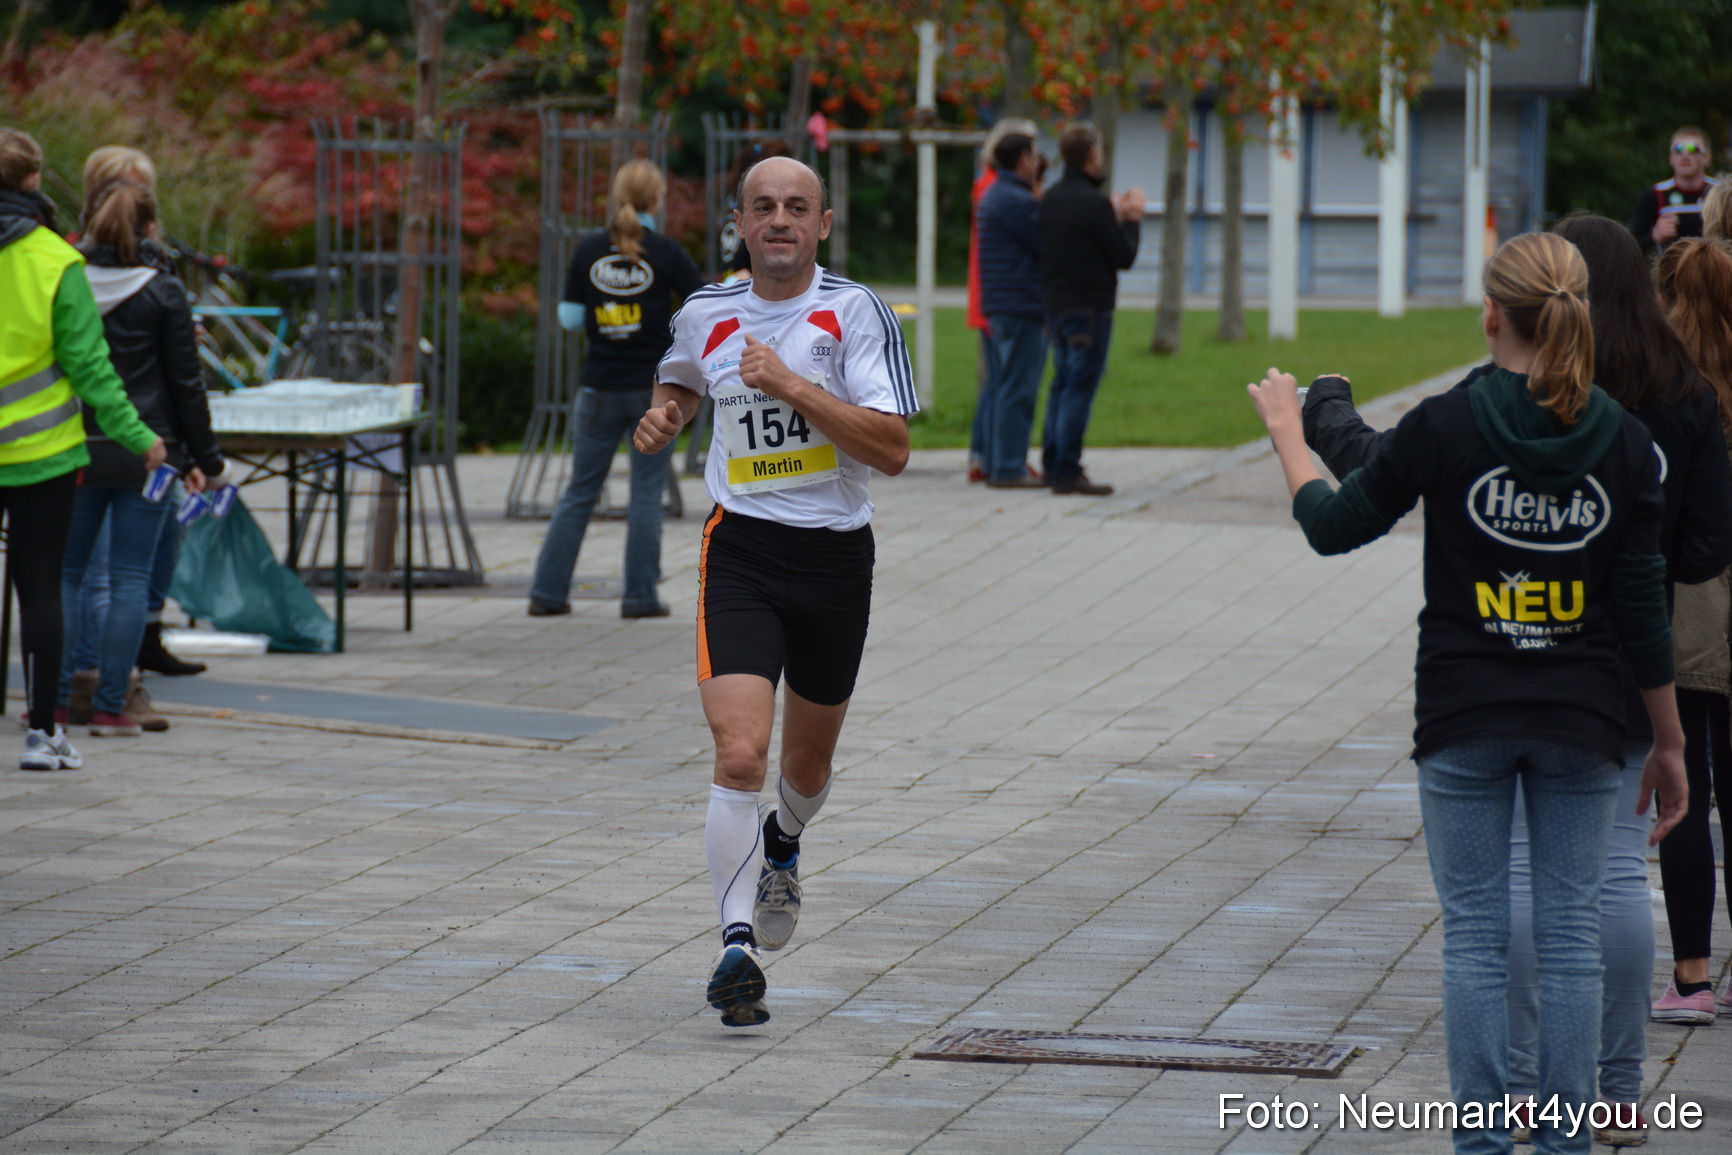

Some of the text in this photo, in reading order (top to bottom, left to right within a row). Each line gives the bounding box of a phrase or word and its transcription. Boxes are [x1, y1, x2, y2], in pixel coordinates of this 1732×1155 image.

[719, 393, 778, 408] PARTL Neu
[738, 407, 811, 450] 154
[752, 457, 803, 477] Martin
[1485, 478, 1597, 532] Hervis
[1493, 519, 1548, 533] SPORTS
[1476, 580, 1584, 622] NEU
[1484, 621, 1584, 636] IN NEUMARKT
